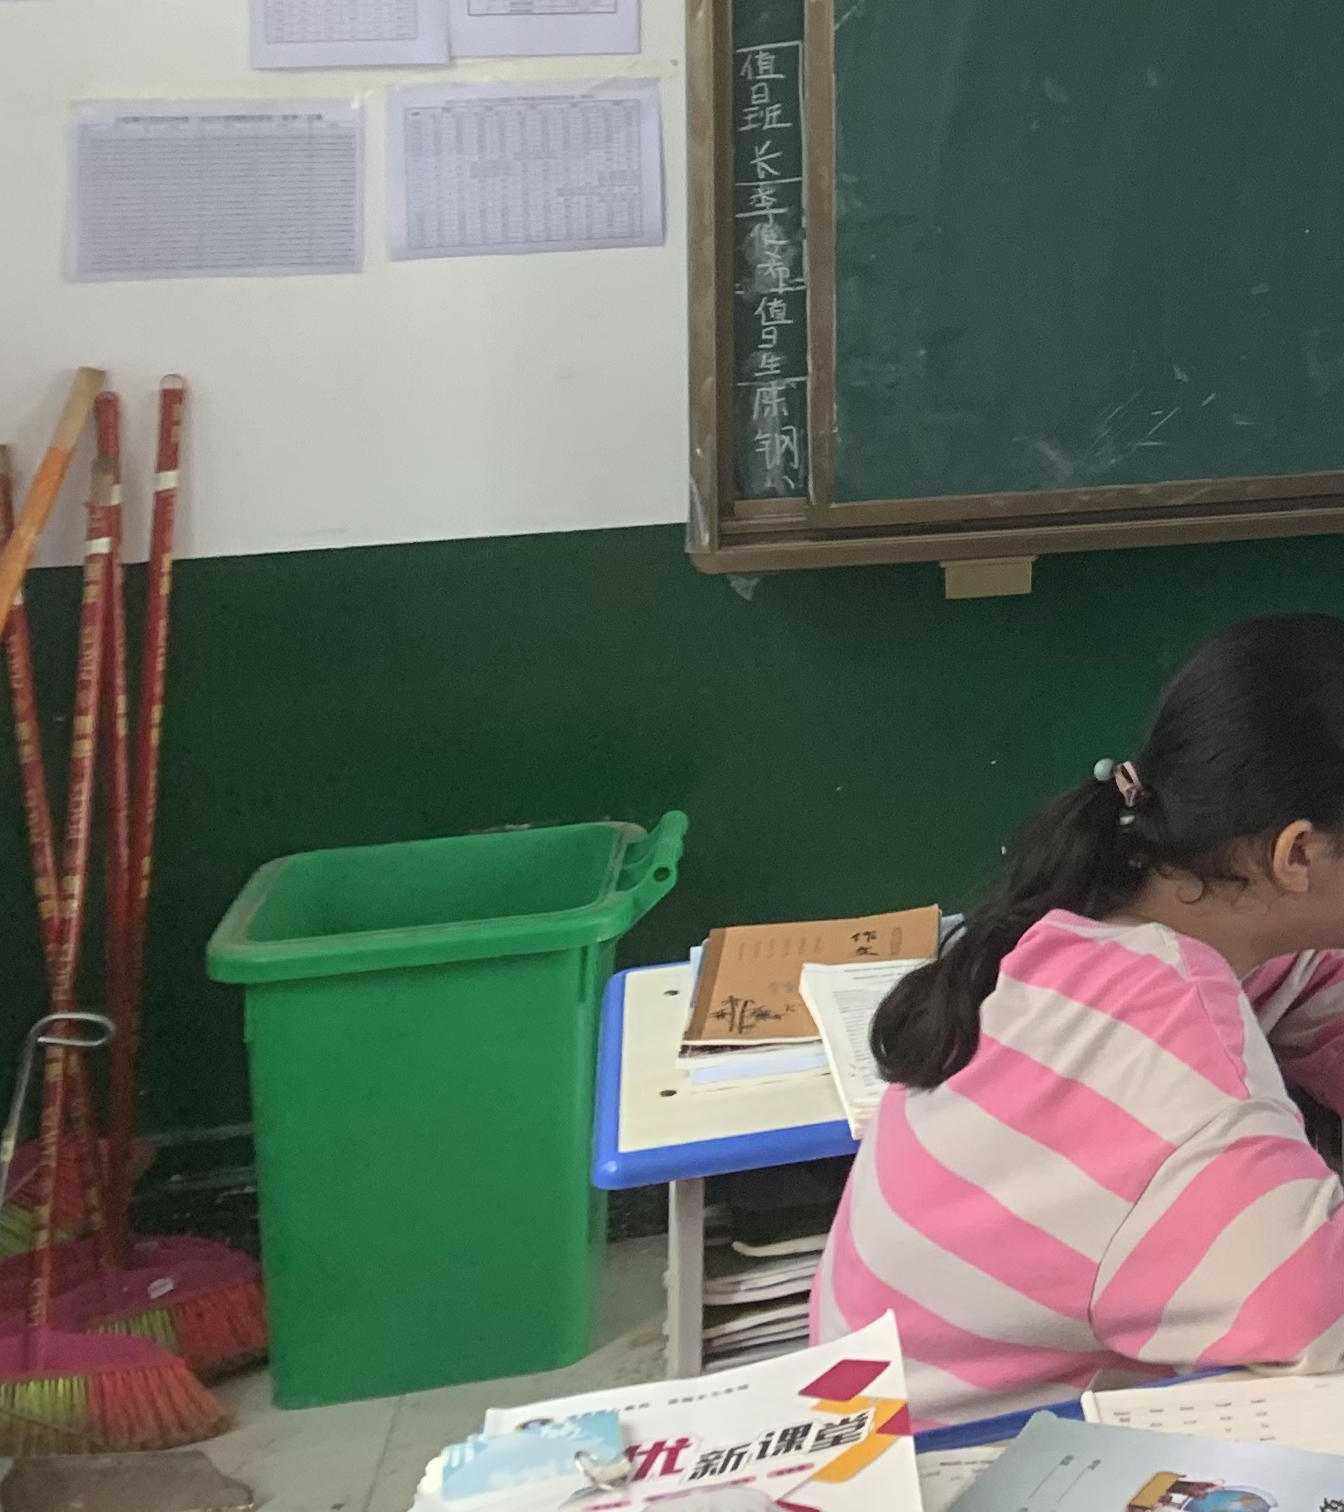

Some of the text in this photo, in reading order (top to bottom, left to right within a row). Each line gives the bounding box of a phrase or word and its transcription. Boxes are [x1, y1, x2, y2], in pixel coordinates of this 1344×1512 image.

[738, 50, 793, 178] 值日班长
[755, 292, 794, 377] 值日生
